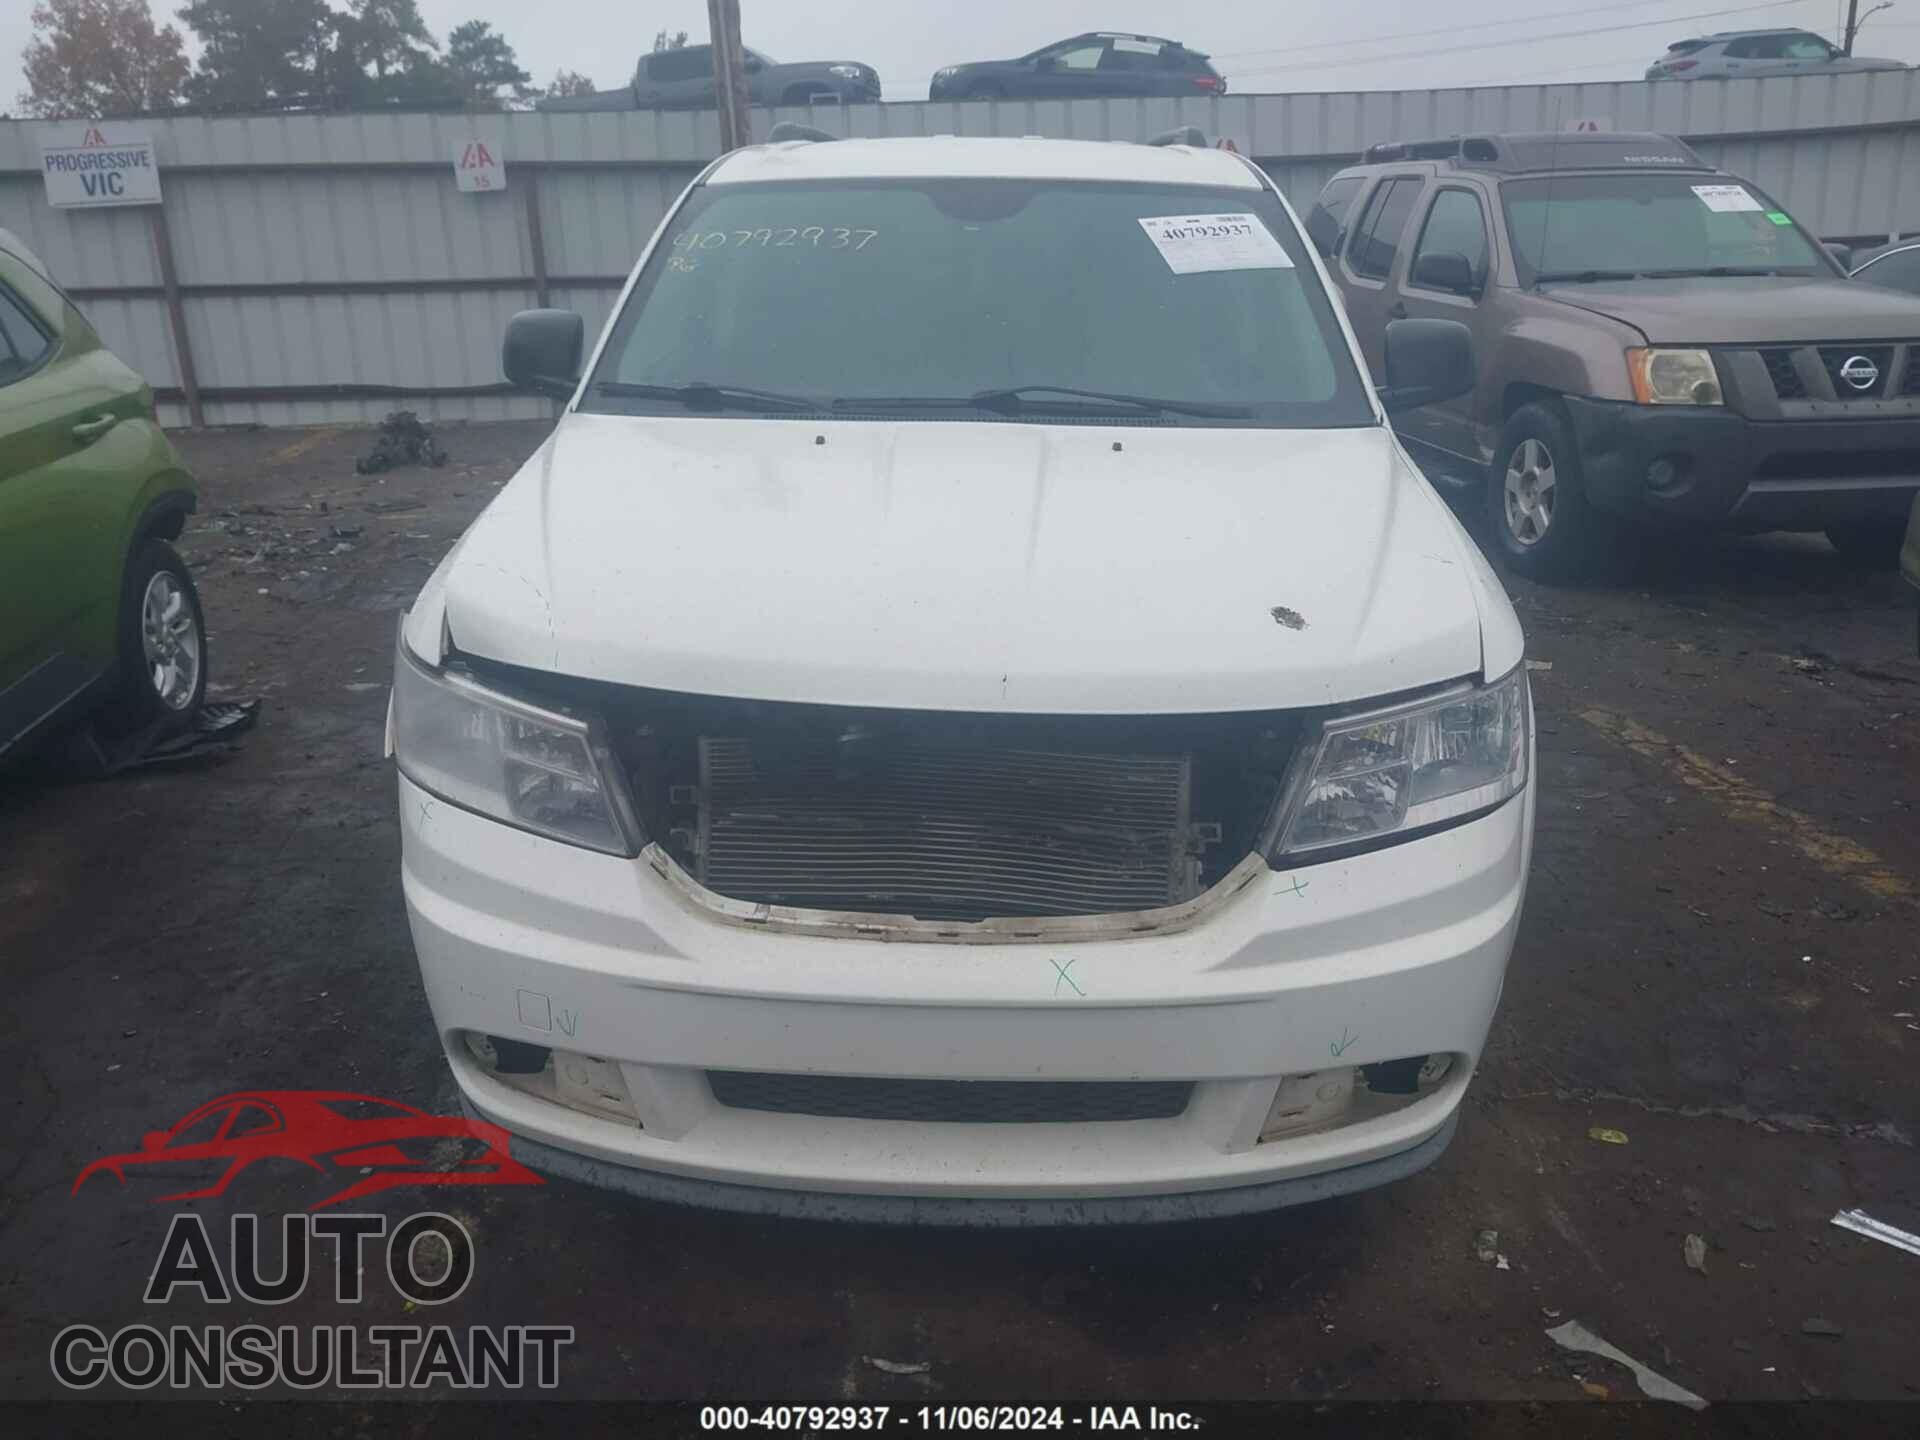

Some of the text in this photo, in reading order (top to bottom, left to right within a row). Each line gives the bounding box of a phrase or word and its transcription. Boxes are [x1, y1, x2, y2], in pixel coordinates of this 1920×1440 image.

[45, 150, 151, 172] PROGRESSIVE
[80, 171, 124, 197] VIC
[672, 226, 878, 251] 40792937
[1162, 224, 1252, 241] 40792937
